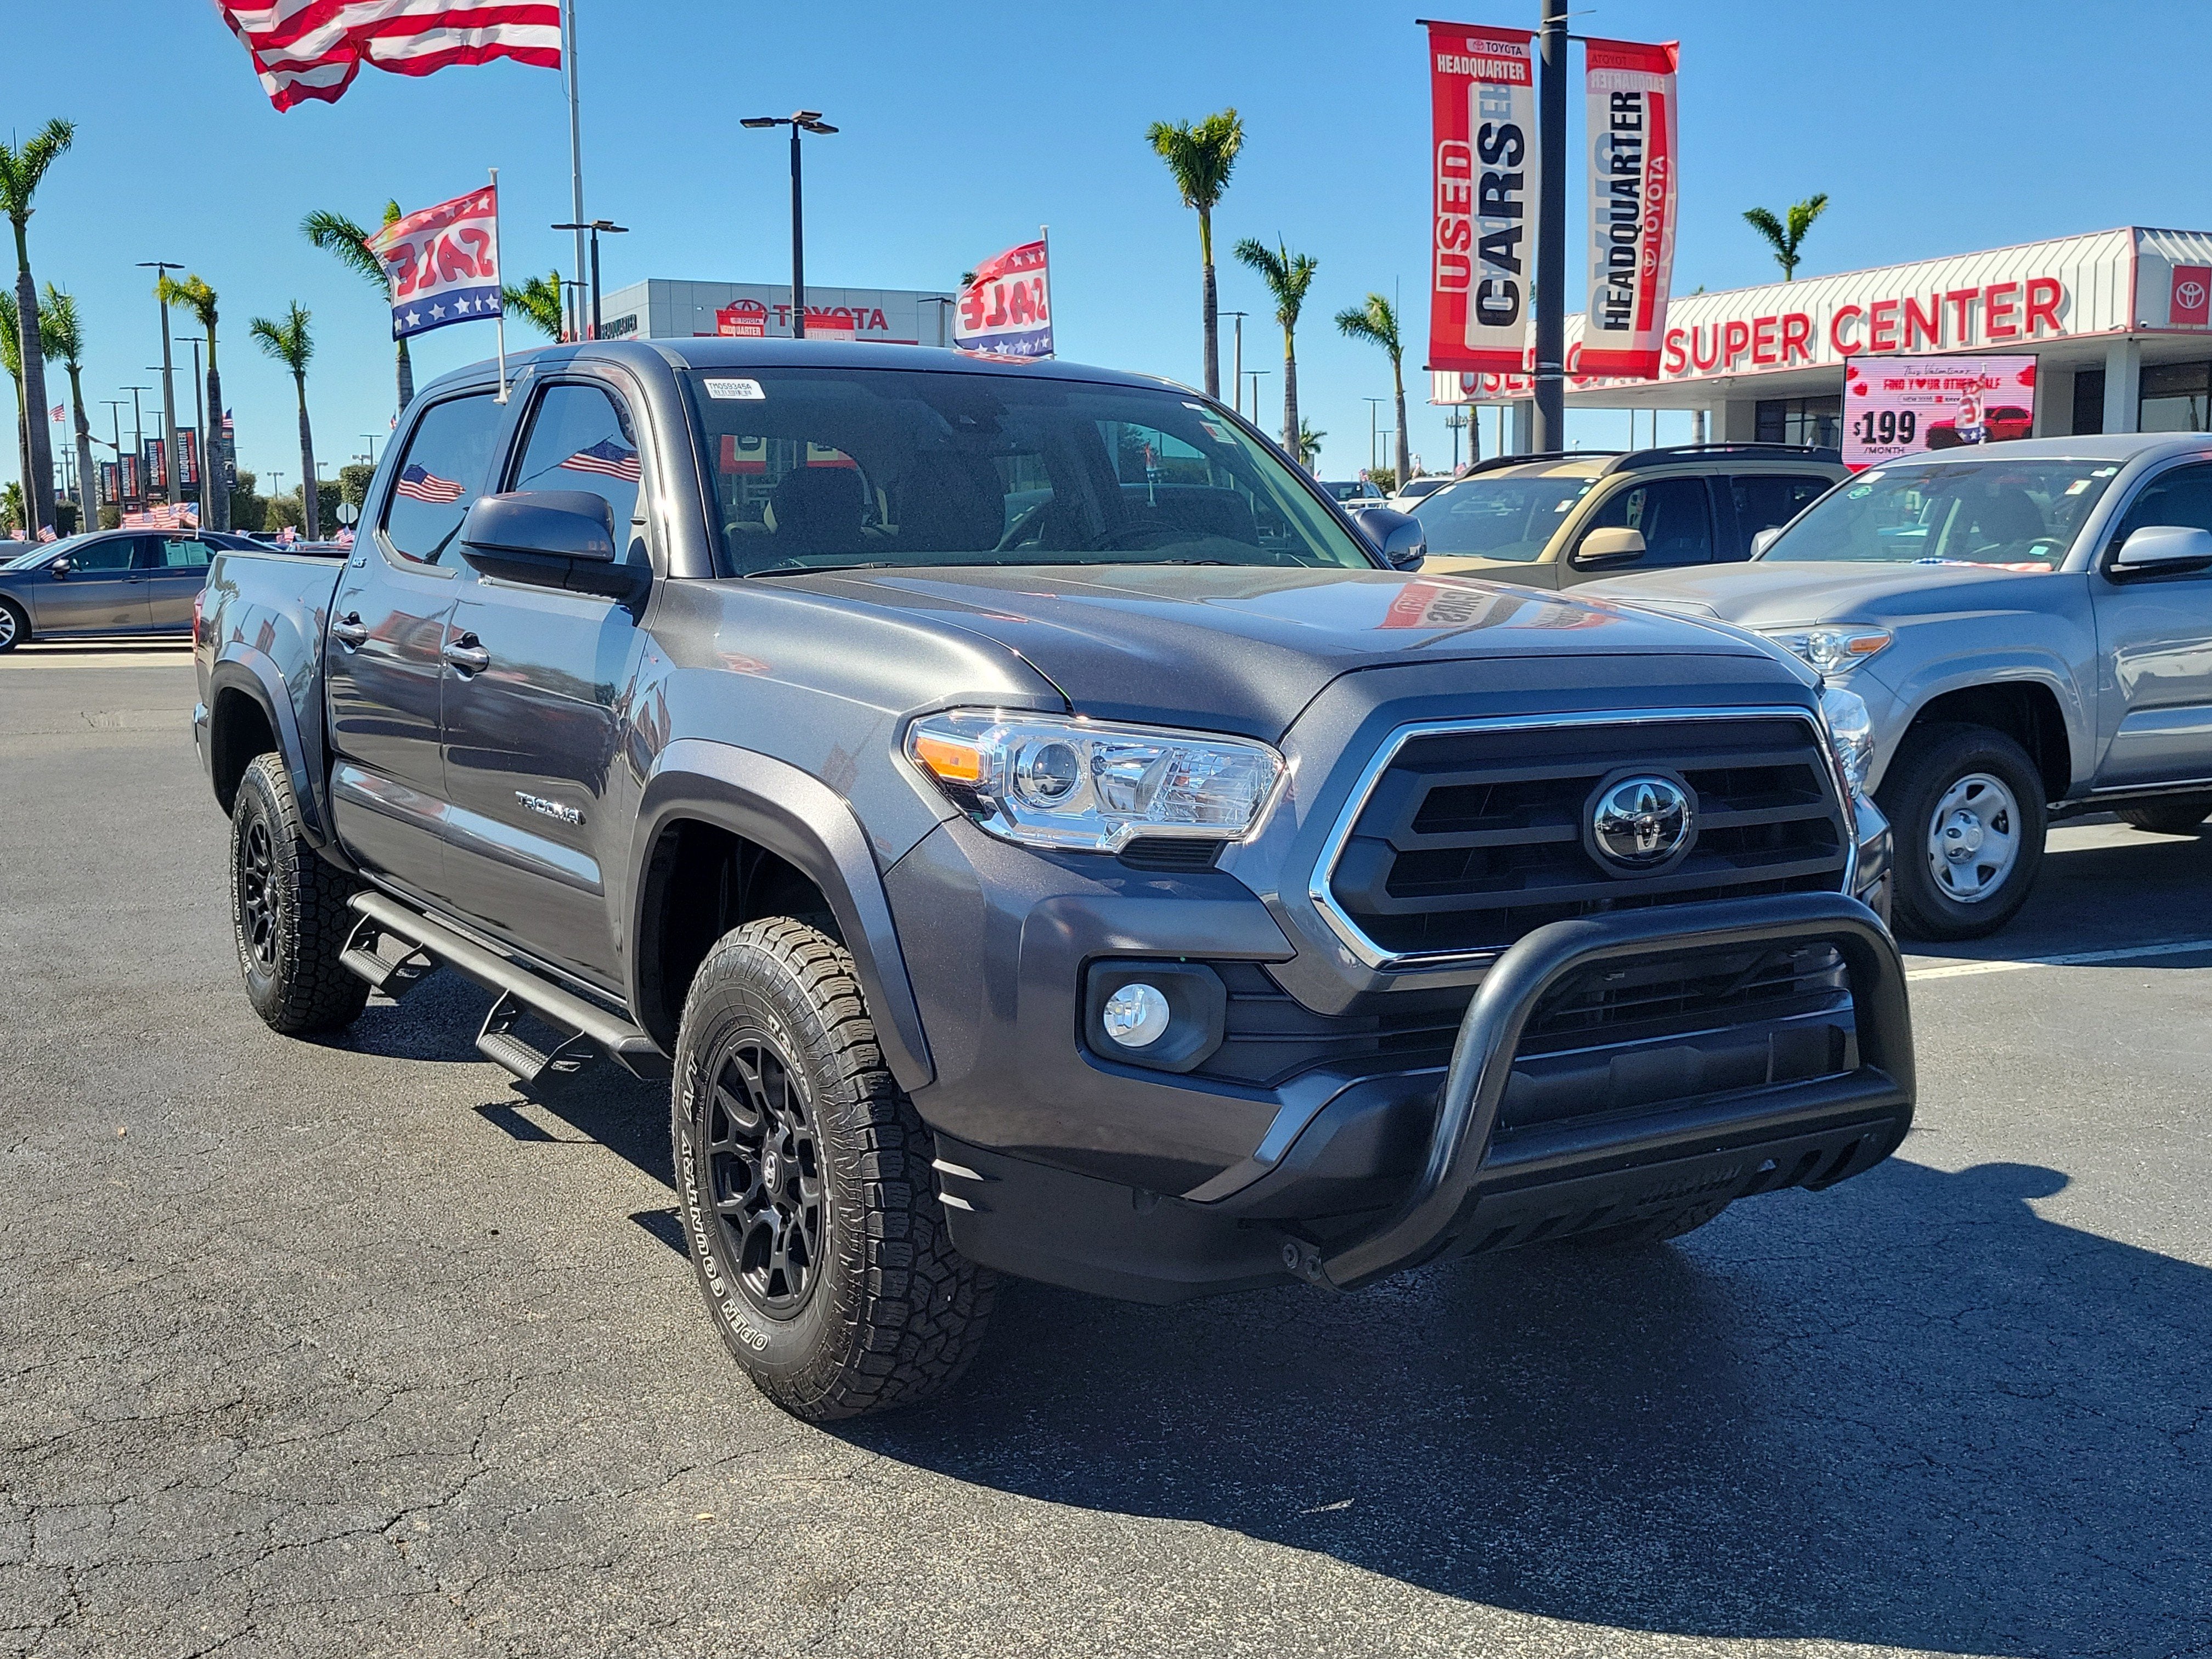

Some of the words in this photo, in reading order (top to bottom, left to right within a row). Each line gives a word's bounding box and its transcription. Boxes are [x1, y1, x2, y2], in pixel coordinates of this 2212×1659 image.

[1437, 54, 1526, 81] HEADQUARTER
[1486, 42, 1522, 55] TOYOTA
[1437, 139, 1471, 293] USED
[1476, 122, 1525, 326] CARS
[1604, 91, 1643, 331] HEADQUARTER
[1646, 156, 1665, 242] TOYOTA
[773, 304, 889, 330] TTA
[1663, 312, 1812, 375] SUPER
[1830, 277, 2062, 357] CENTER
[1853, 410, 1916, 444] $199
[515, 791, 586, 825] TACOMA
[682, 1050, 698, 1122] A/T
[768, 1014, 812, 1103] TOYO
[681, 1132, 725, 1298] COUNTRY
[721, 1298, 769, 1352] OPEN
